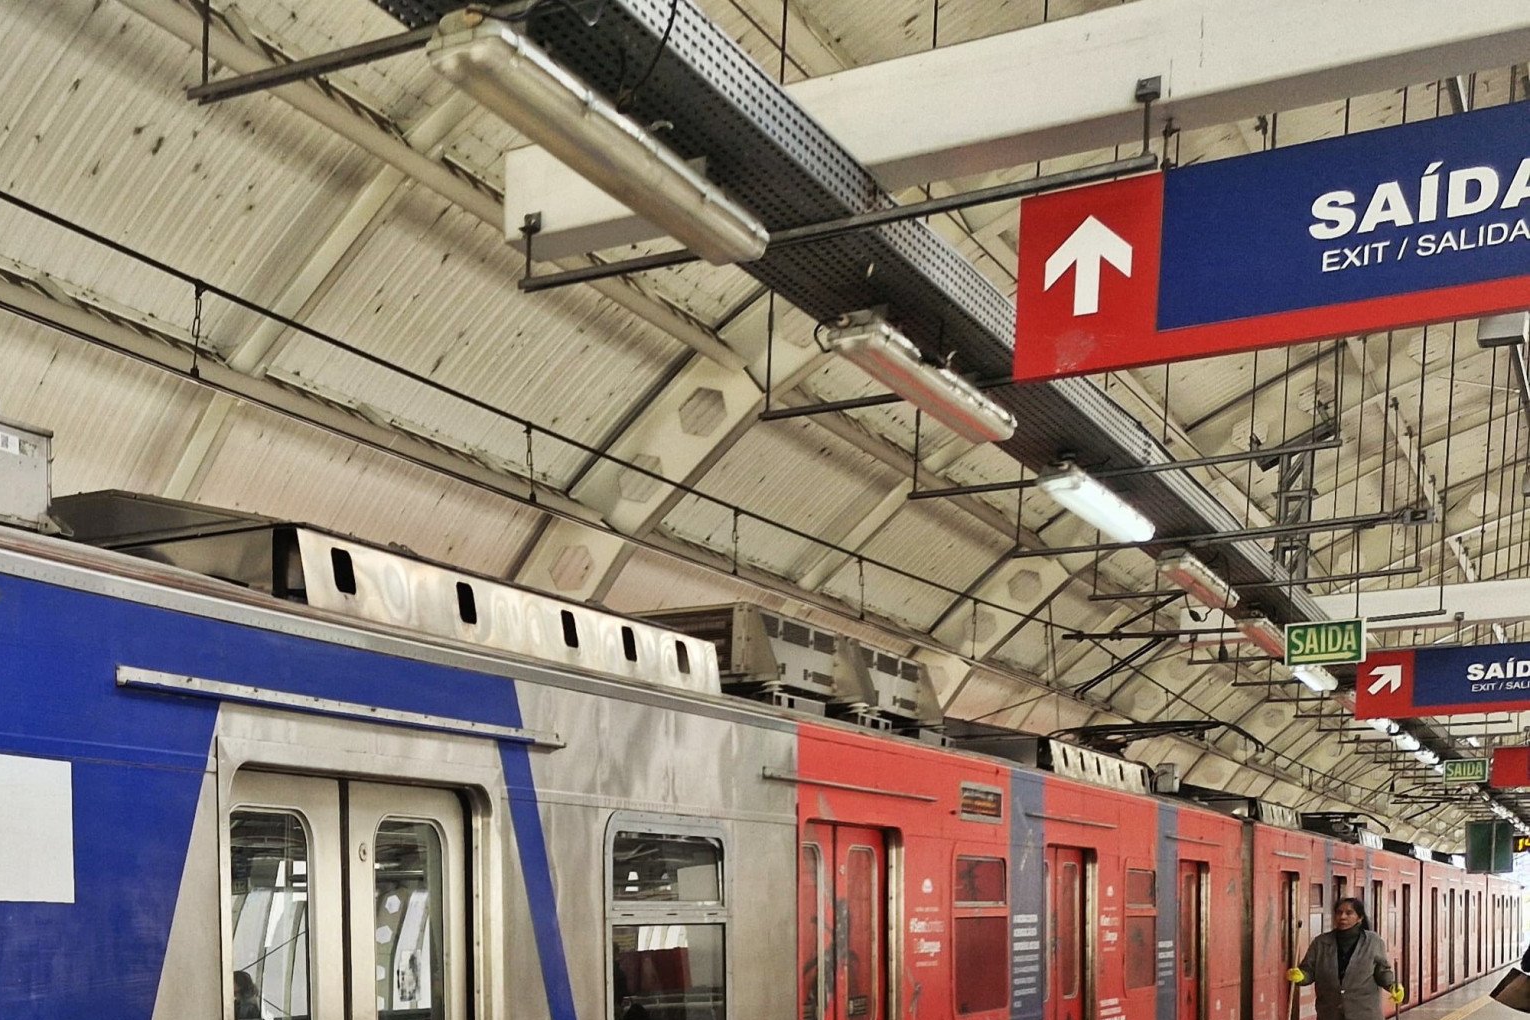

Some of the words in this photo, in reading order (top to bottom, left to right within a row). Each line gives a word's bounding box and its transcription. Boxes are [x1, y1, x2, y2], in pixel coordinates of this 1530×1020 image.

[1308, 158, 1530, 240] SAÍDA
[1322, 241, 1391, 273] EXIT
[1416, 218, 1530, 257] SALIDA
[1471, 682, 1496, 692] EXIT
